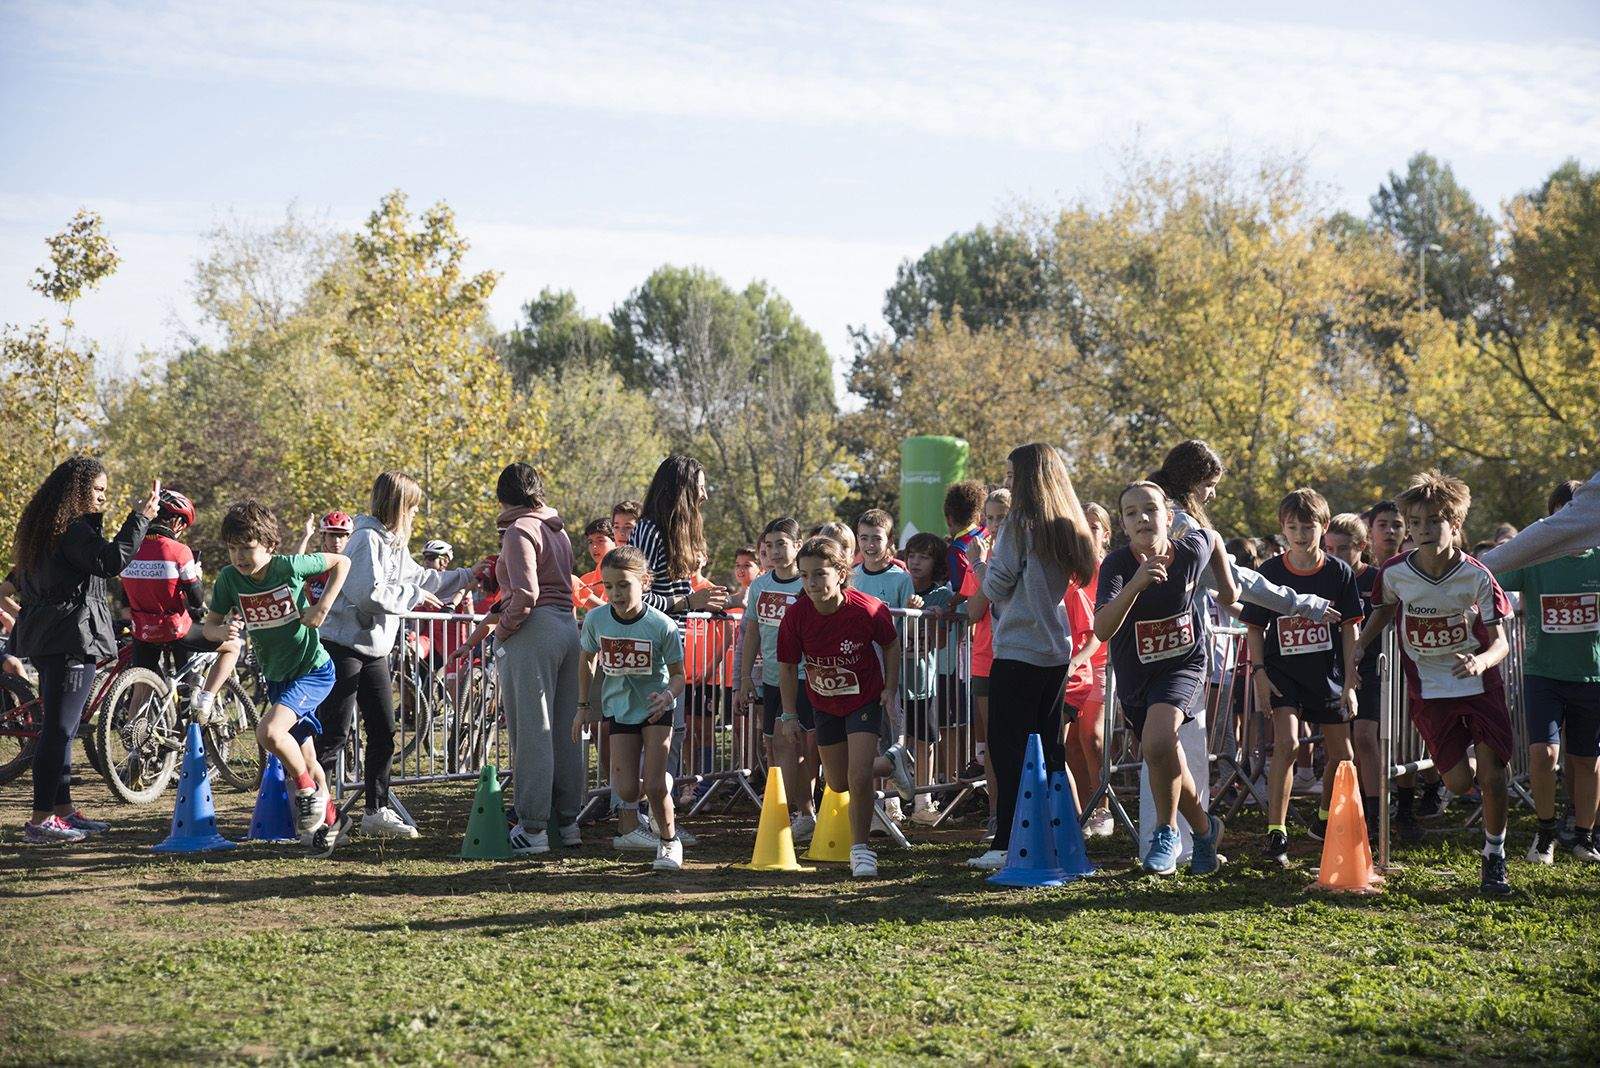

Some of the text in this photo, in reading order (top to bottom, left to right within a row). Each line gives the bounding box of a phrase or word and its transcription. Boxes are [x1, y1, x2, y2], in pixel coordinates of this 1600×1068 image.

[246, 600, 294, 622] 3382
[760, 602, 786, 619] 134
[1546, 606, 1596, 624] 3385
[1142, 627, 1191, 654] 3758
[1282, 626, 1328, 646] 3760
[1410, 627, 1465, 646] 1489
[604, 651, 649, 668] 1349
[815, 676, 849, 690] 402
